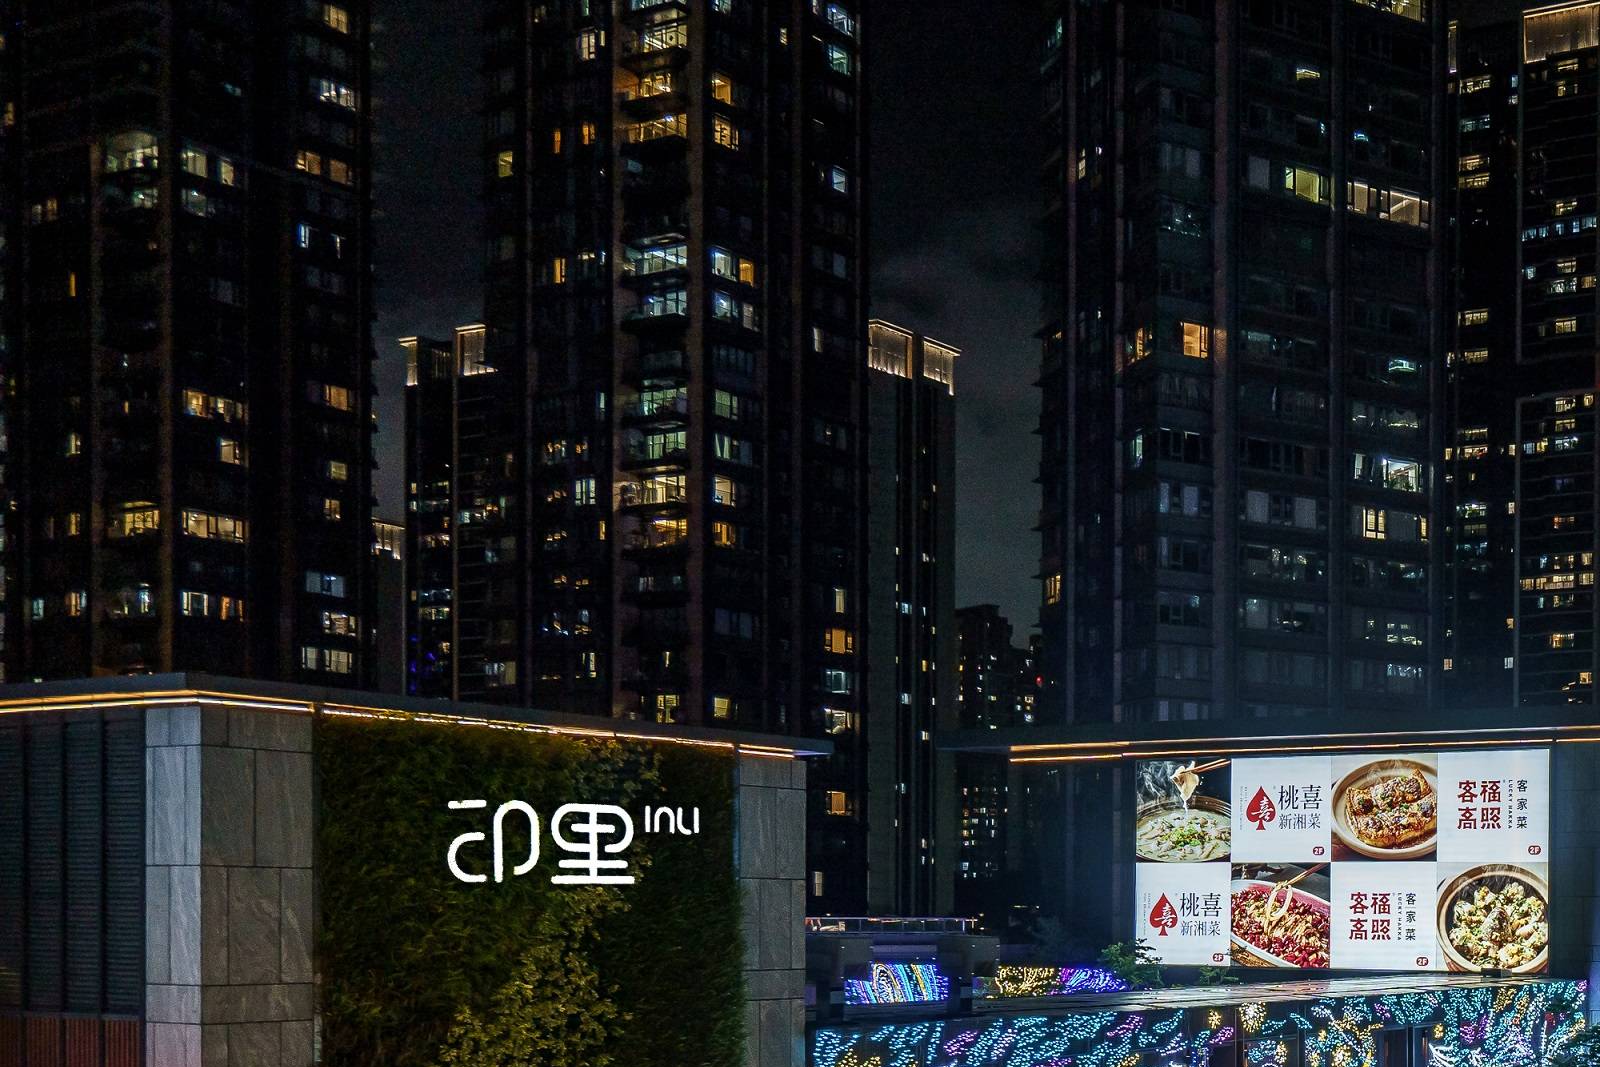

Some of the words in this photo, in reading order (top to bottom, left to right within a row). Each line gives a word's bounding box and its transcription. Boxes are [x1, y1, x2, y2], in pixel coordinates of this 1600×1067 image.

[1278, 785, 1323, 810] 桃喜
[1517, 779, 1528, 829] 客家菜
[1279, 813, 1321, 830] 新湘菜
[1313, 847, 1324, 855] 2F
[1529, 846, 1540, 854] 2F
[1179, 893, 1223, 917] 桃喜
[1405, 893, 1416, 940] 客家菜
[1180, 920, 1221, 936] 新湘菜
[1213, 953, 1224, 962] 2F
[1417, 958, 1428, 966] 2F
